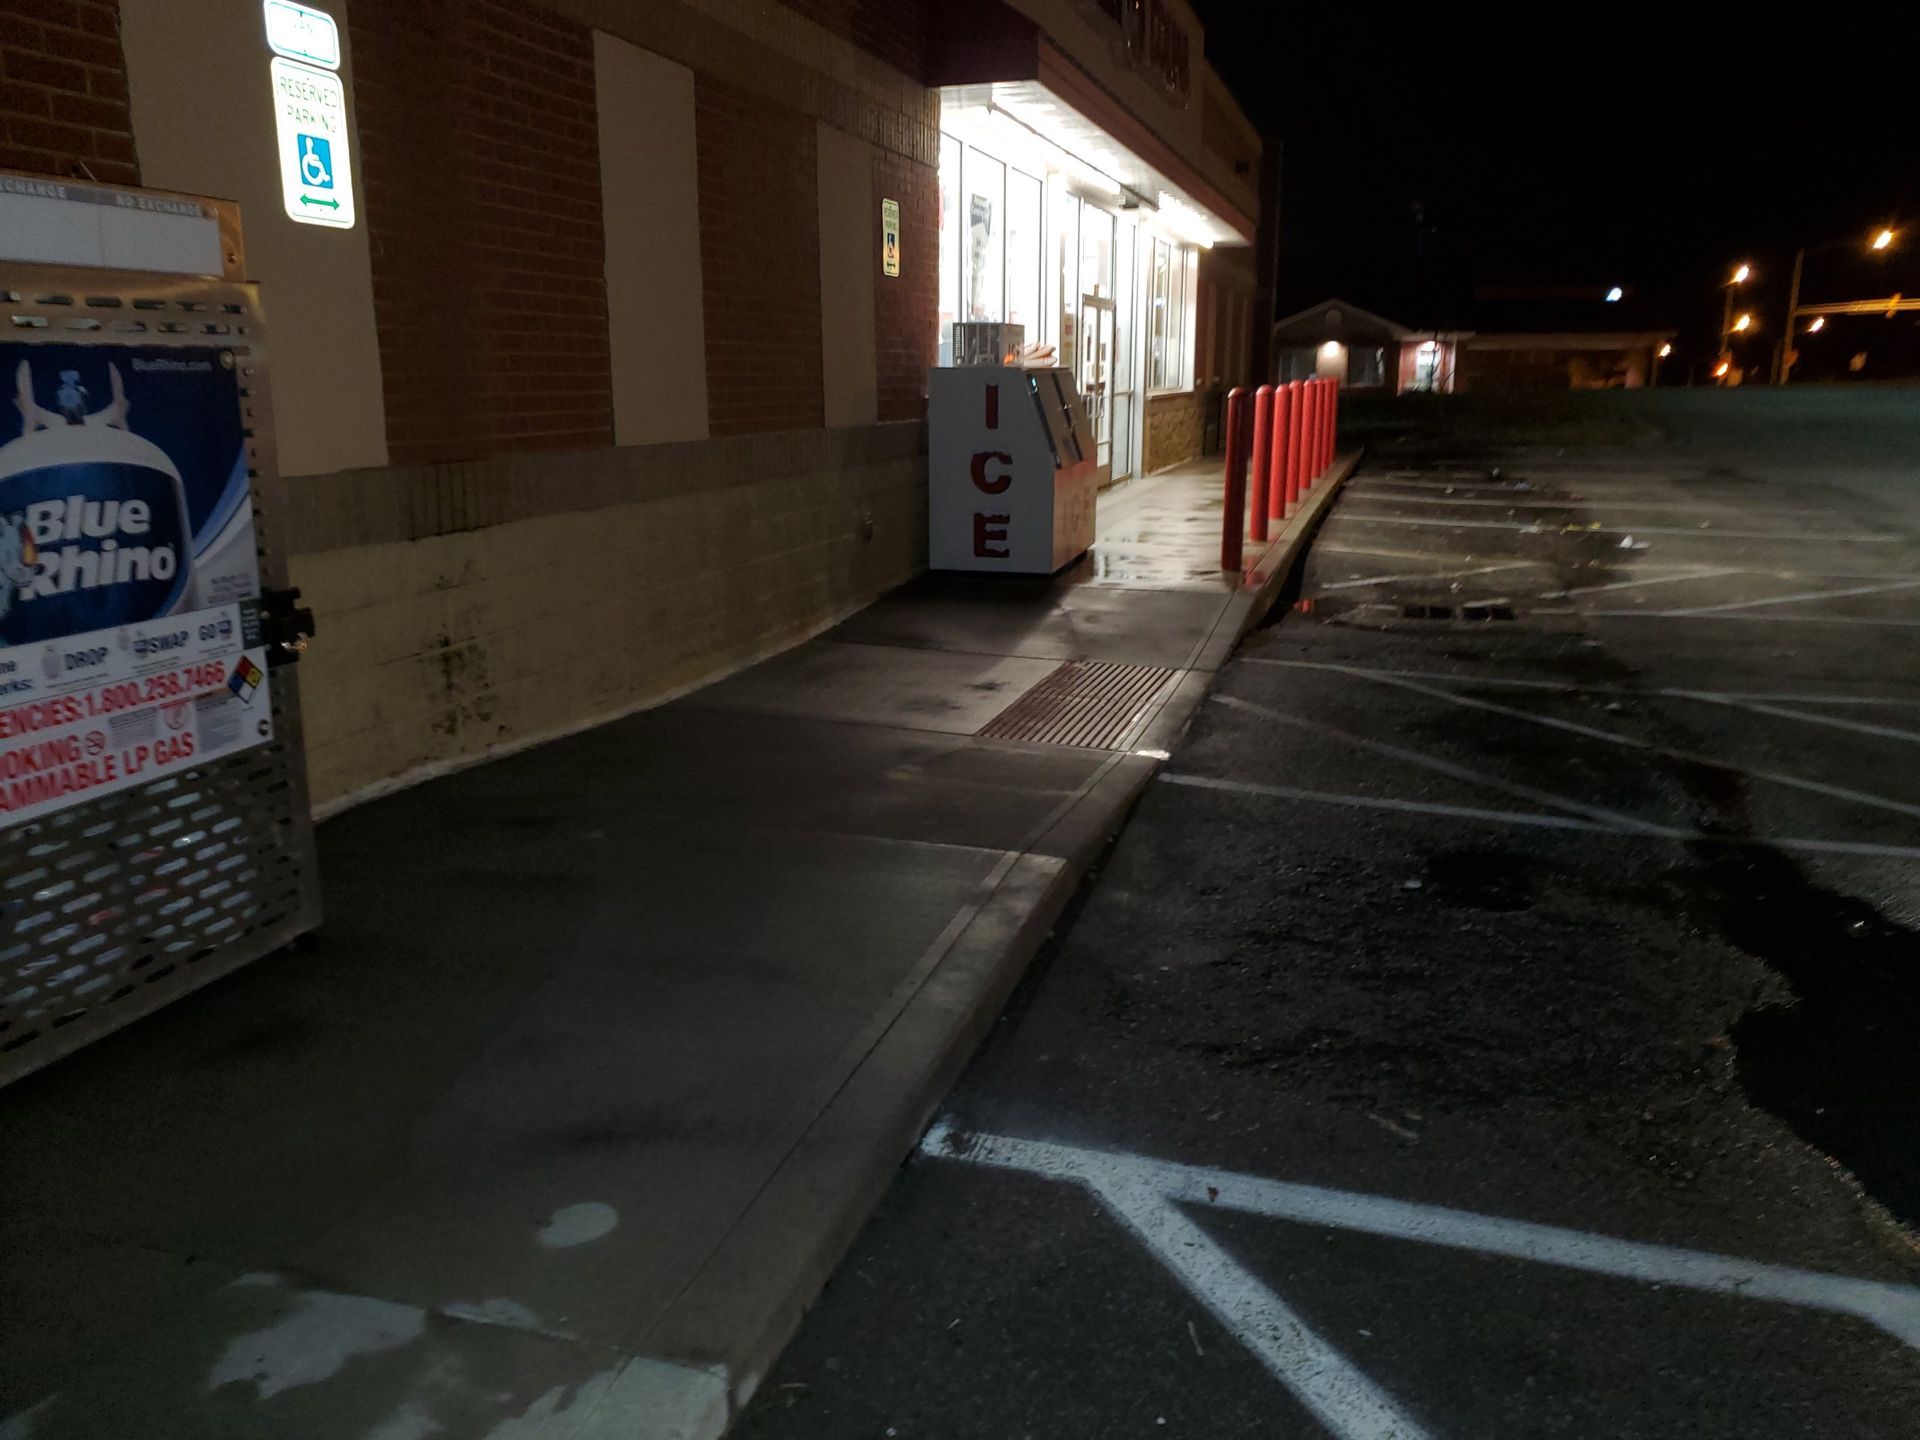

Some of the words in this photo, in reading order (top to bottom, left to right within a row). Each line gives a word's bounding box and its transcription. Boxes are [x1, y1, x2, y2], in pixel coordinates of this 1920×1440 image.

[279, 75, 337, 108] RESERVED
[285, 104, 337, 134] PARKNG
[970, 384, 1013, 558] ICE
[26, 494, 152, 544] Blue
[19, 538, 177, 602] Rhino
[123, 745, 150, 776] LP
[154, 732, 194, 766] GAS
